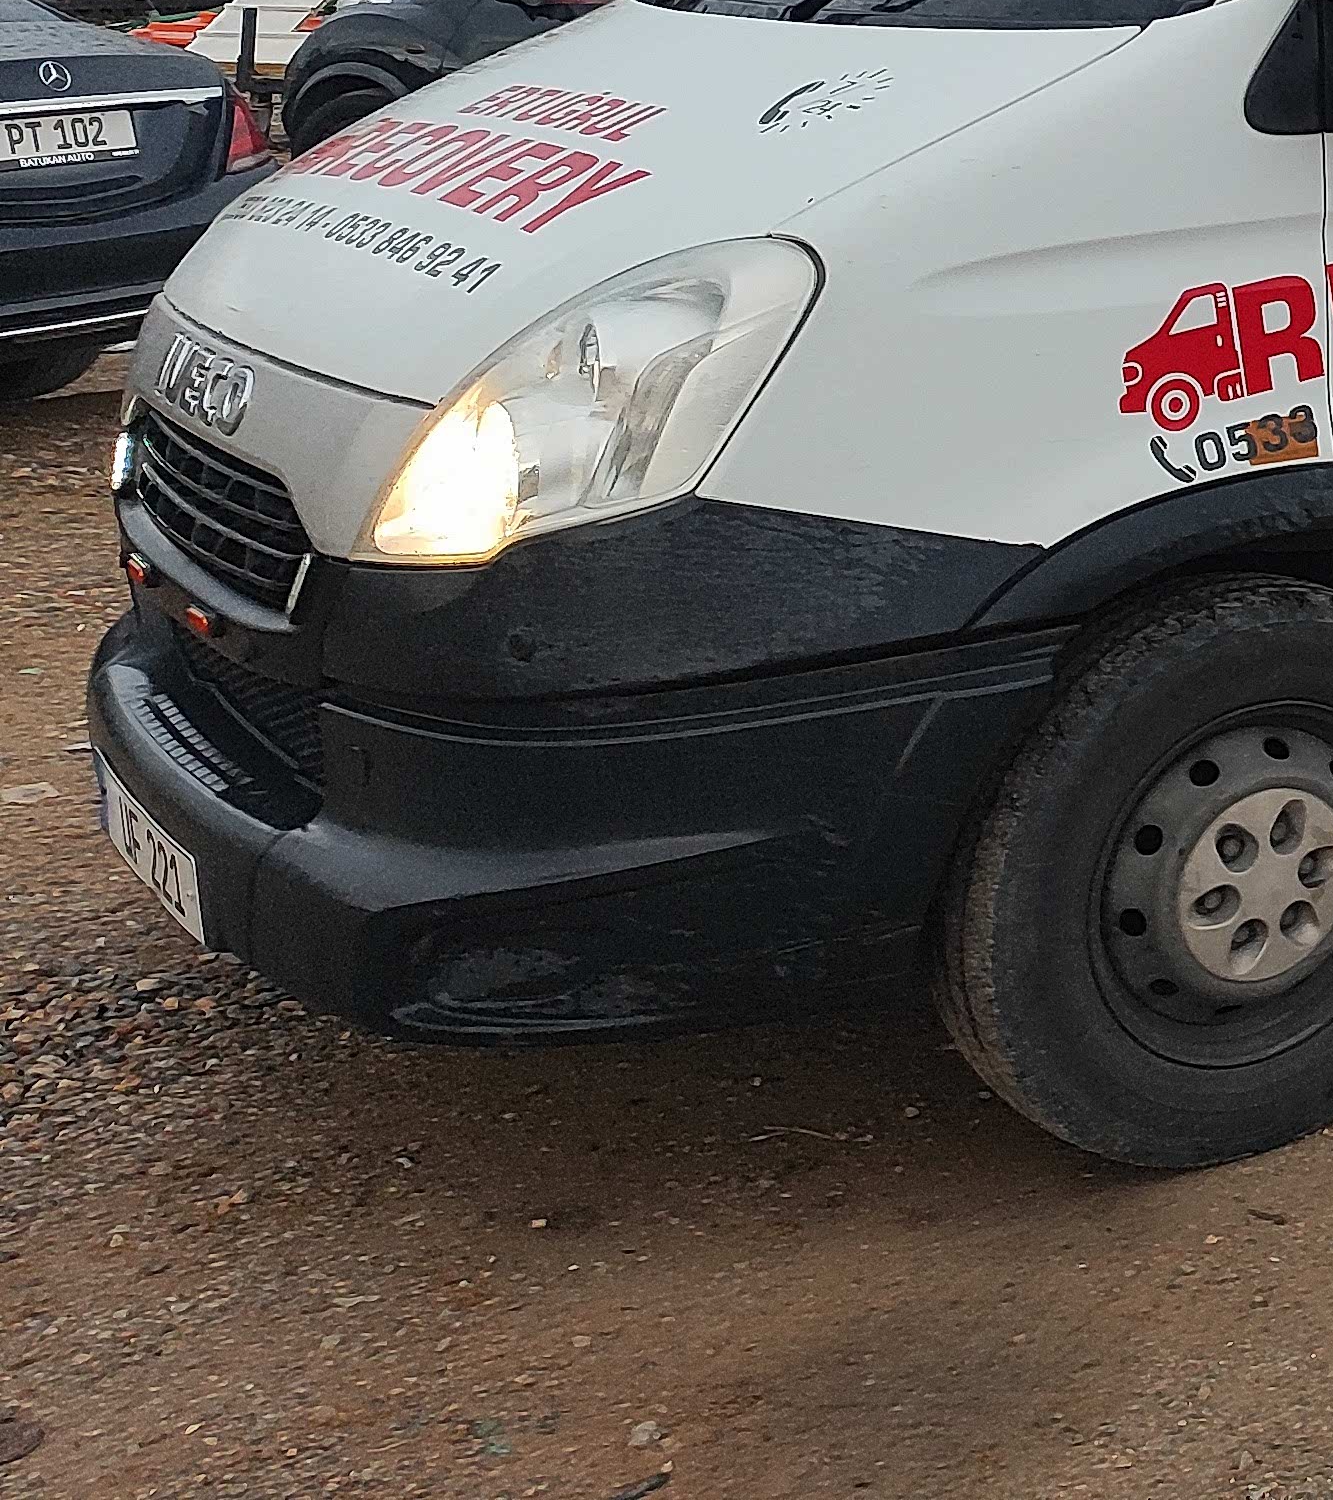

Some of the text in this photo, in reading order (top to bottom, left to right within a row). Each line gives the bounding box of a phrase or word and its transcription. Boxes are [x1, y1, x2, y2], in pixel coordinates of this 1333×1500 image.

[4, 116, 108, 155] PT 102
[67, 152, 95, 162] AUTO
[290, 117, 653, 234] RECOVERY
[295, 205, 337, 232] 14
[325, 212, 388, 249] 0533
[372, 227, 434, 264] 846
[414, 242, 466, 278] 92
[450, 257, 502, 294] 41
[155, 333, 254, 437] IVECO
[1195, 404, 1318, 472] 0533
[147, 828, 186, 918] 221
